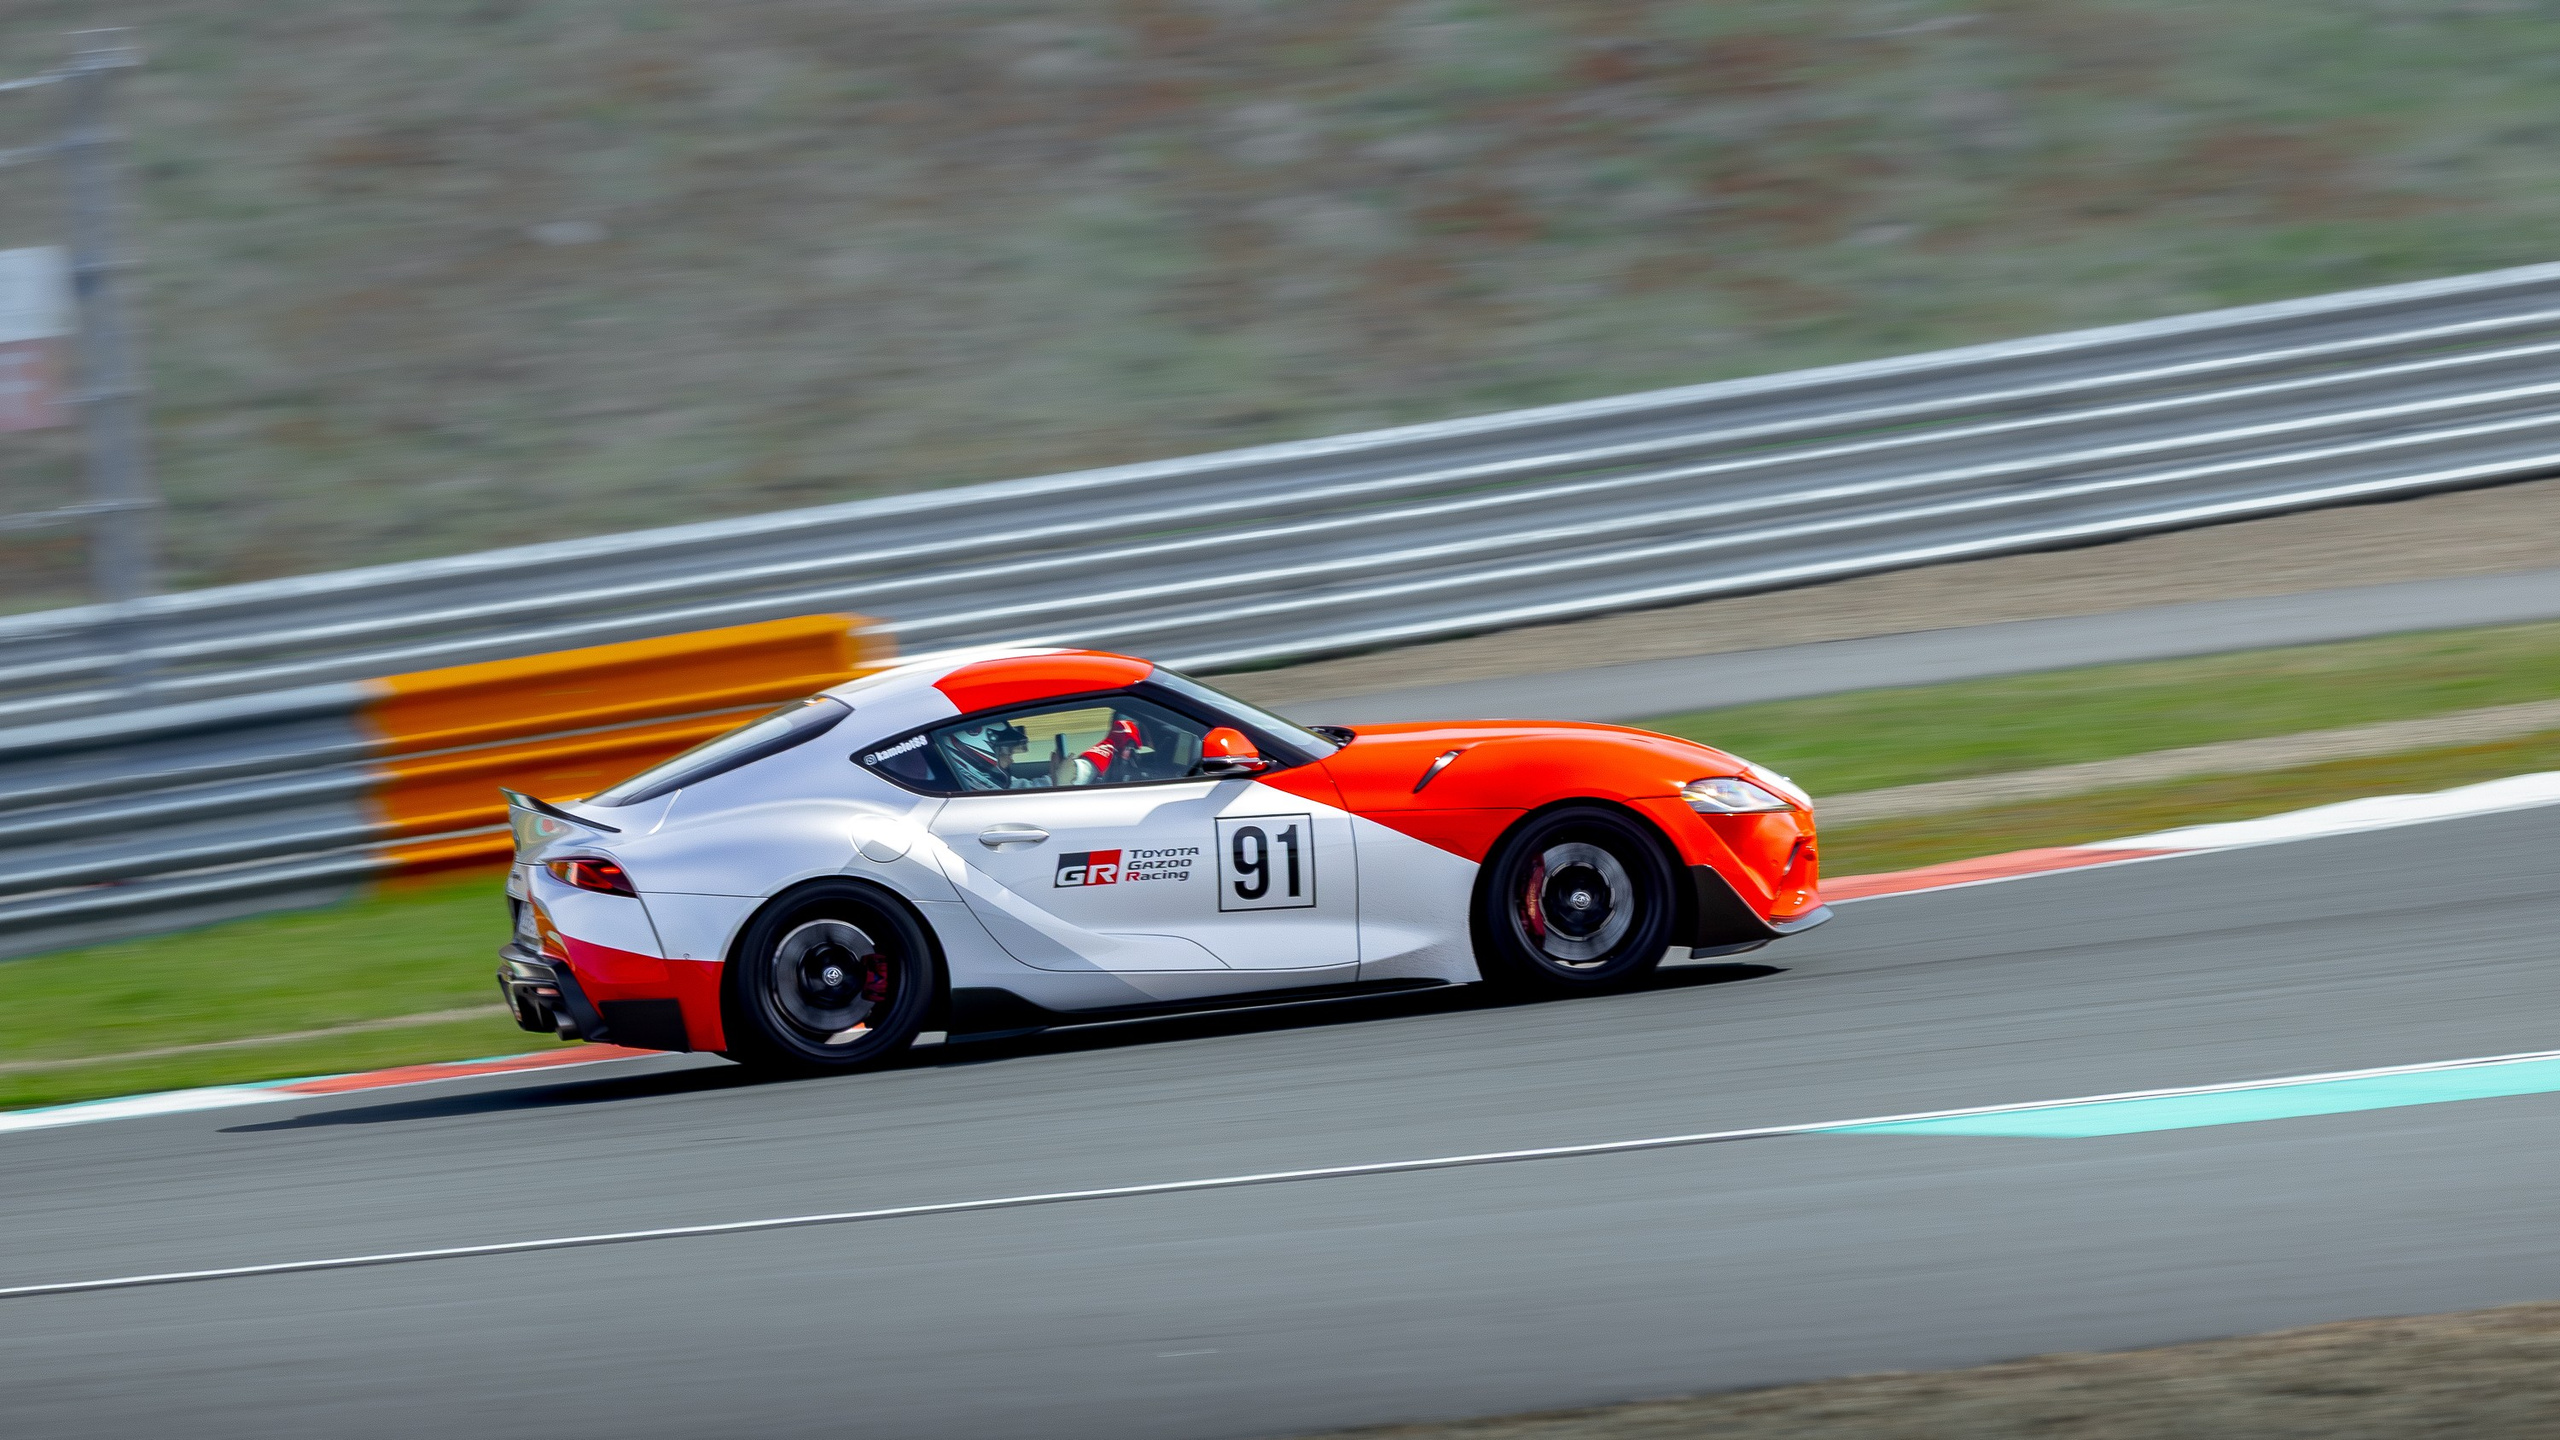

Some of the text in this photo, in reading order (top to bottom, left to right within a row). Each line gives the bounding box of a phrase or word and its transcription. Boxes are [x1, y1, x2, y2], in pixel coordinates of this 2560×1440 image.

[1129, 847, 1199, 859] TOYOTA
[1127, 859, 1192, 870] GAZOO
[1233, 824, 1301, 900] 91
[1056, 863, 1118, 885] GR
[1125, 870, 1190, 881] Racing
